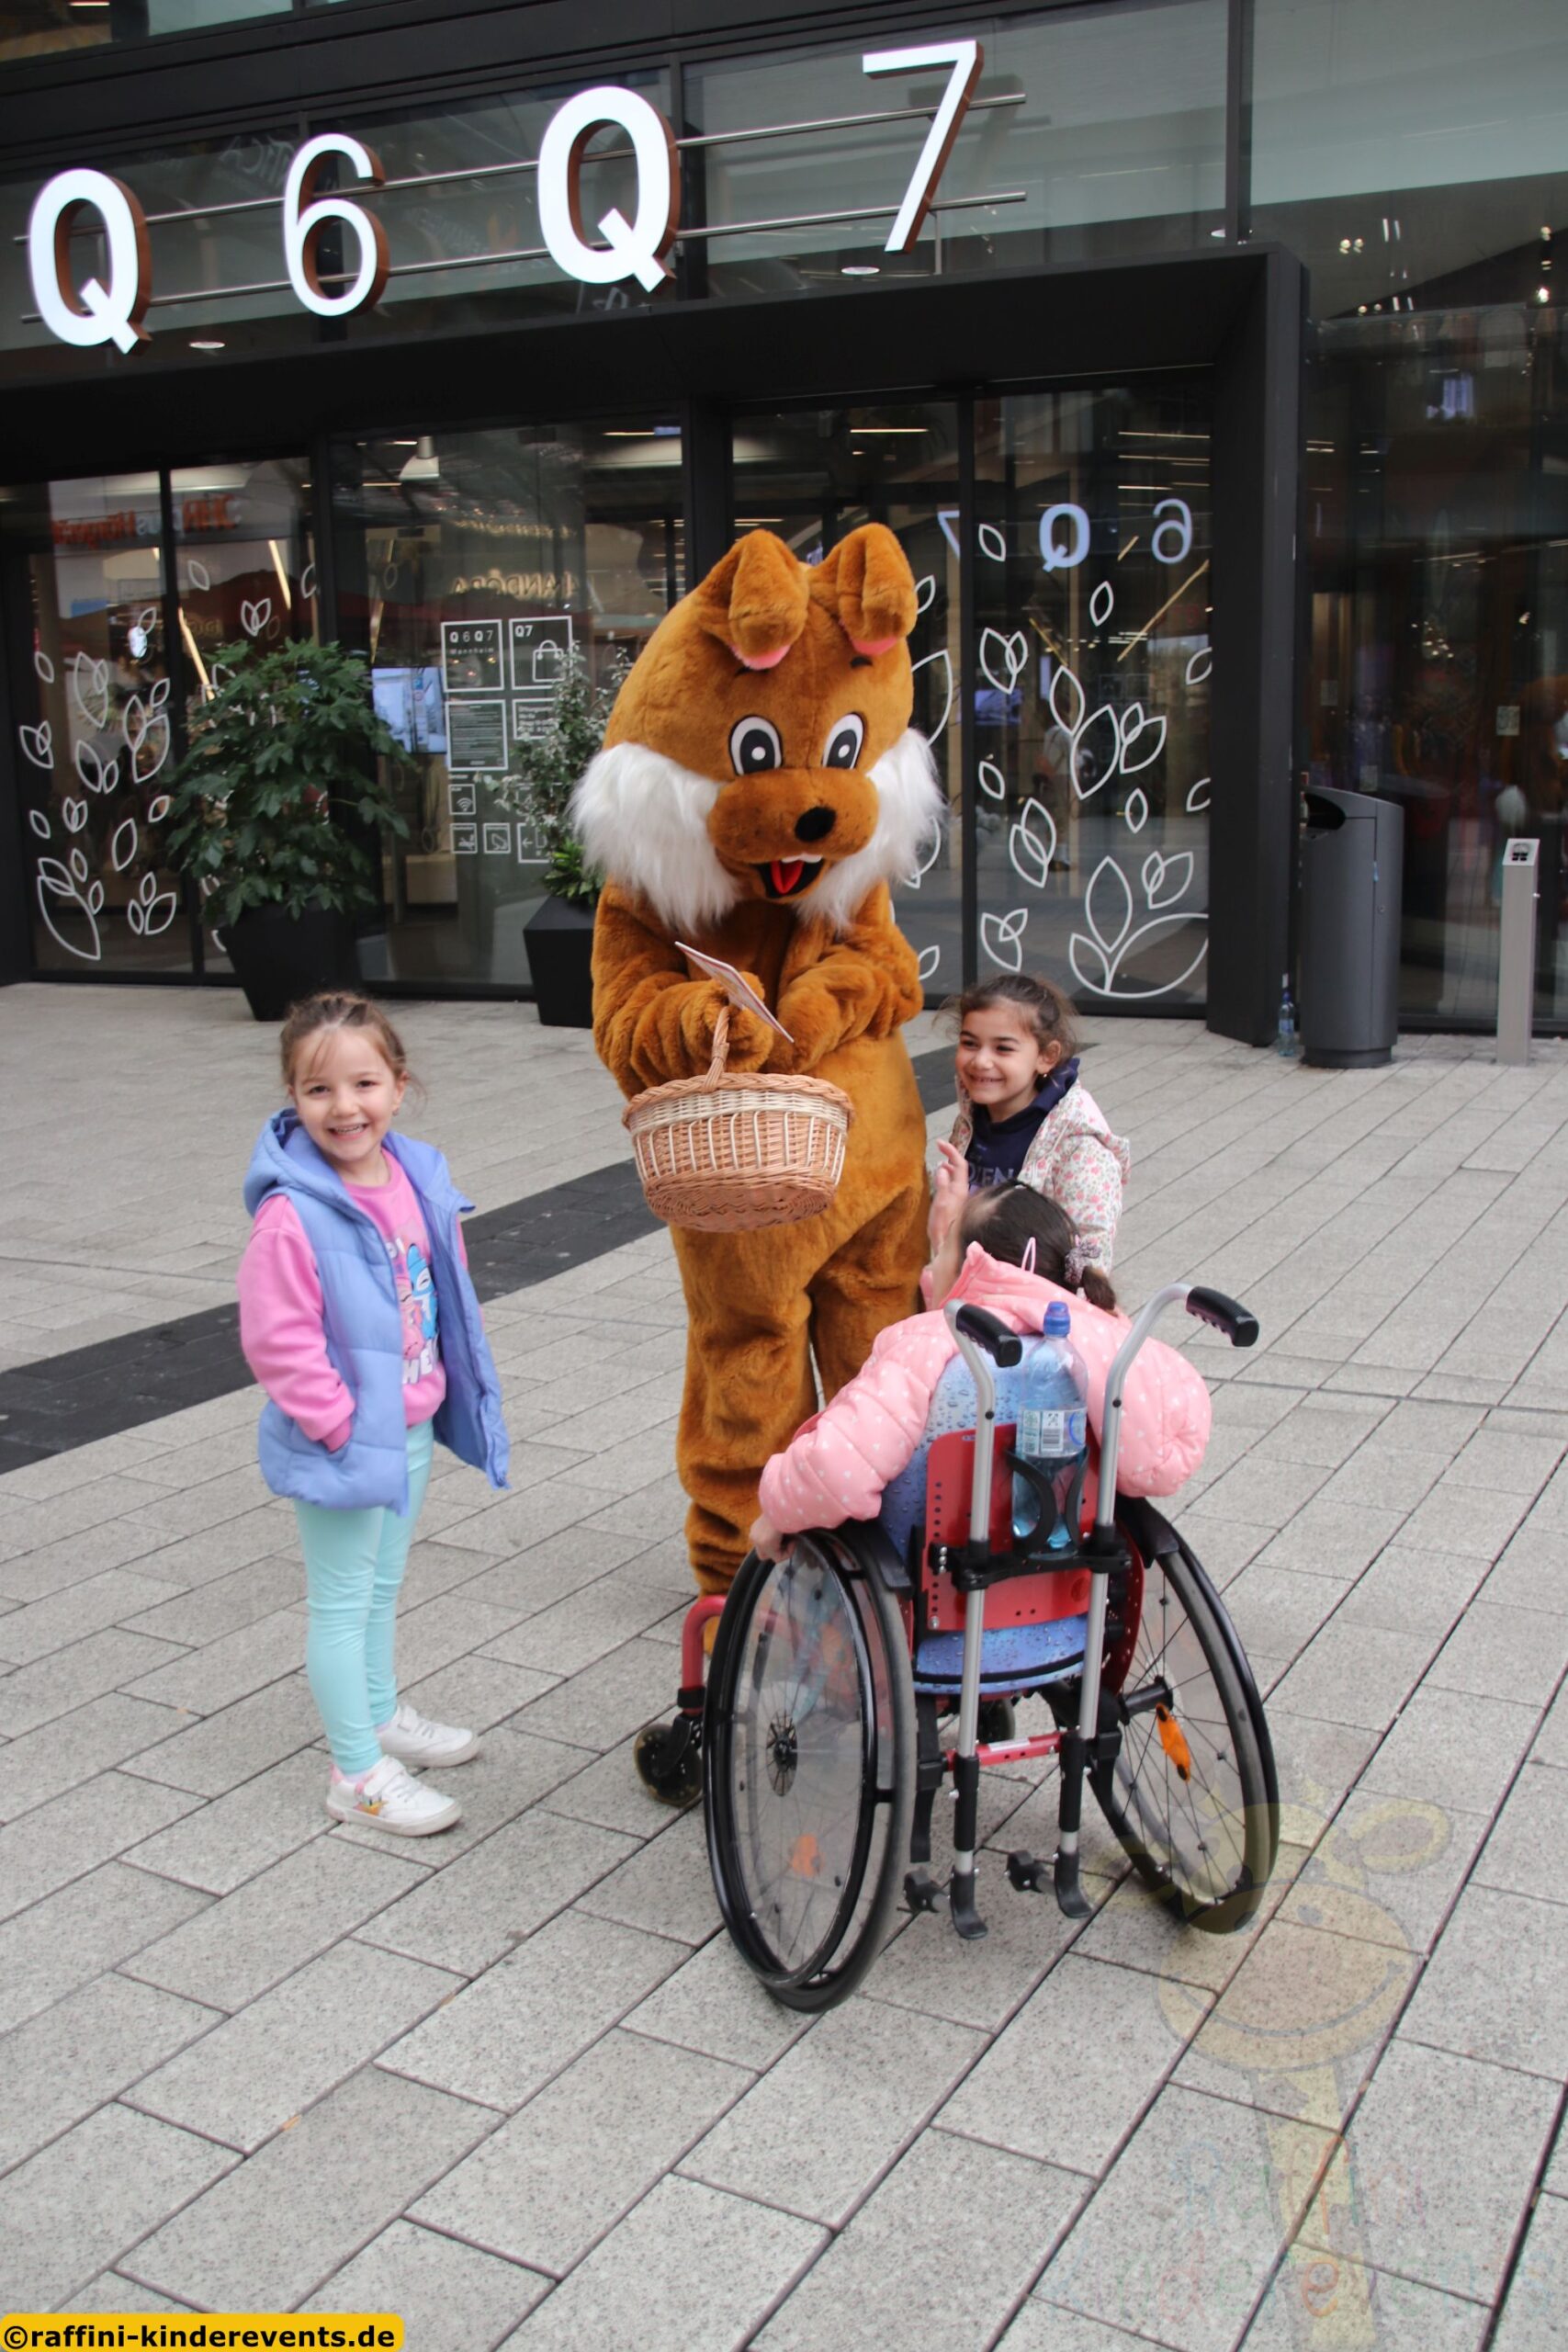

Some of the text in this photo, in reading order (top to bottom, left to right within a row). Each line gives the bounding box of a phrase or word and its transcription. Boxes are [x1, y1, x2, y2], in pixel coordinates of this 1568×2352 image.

[28, 39, 984, 356] Q 6 Q 7
[514, 625, 534, 638] Q7
